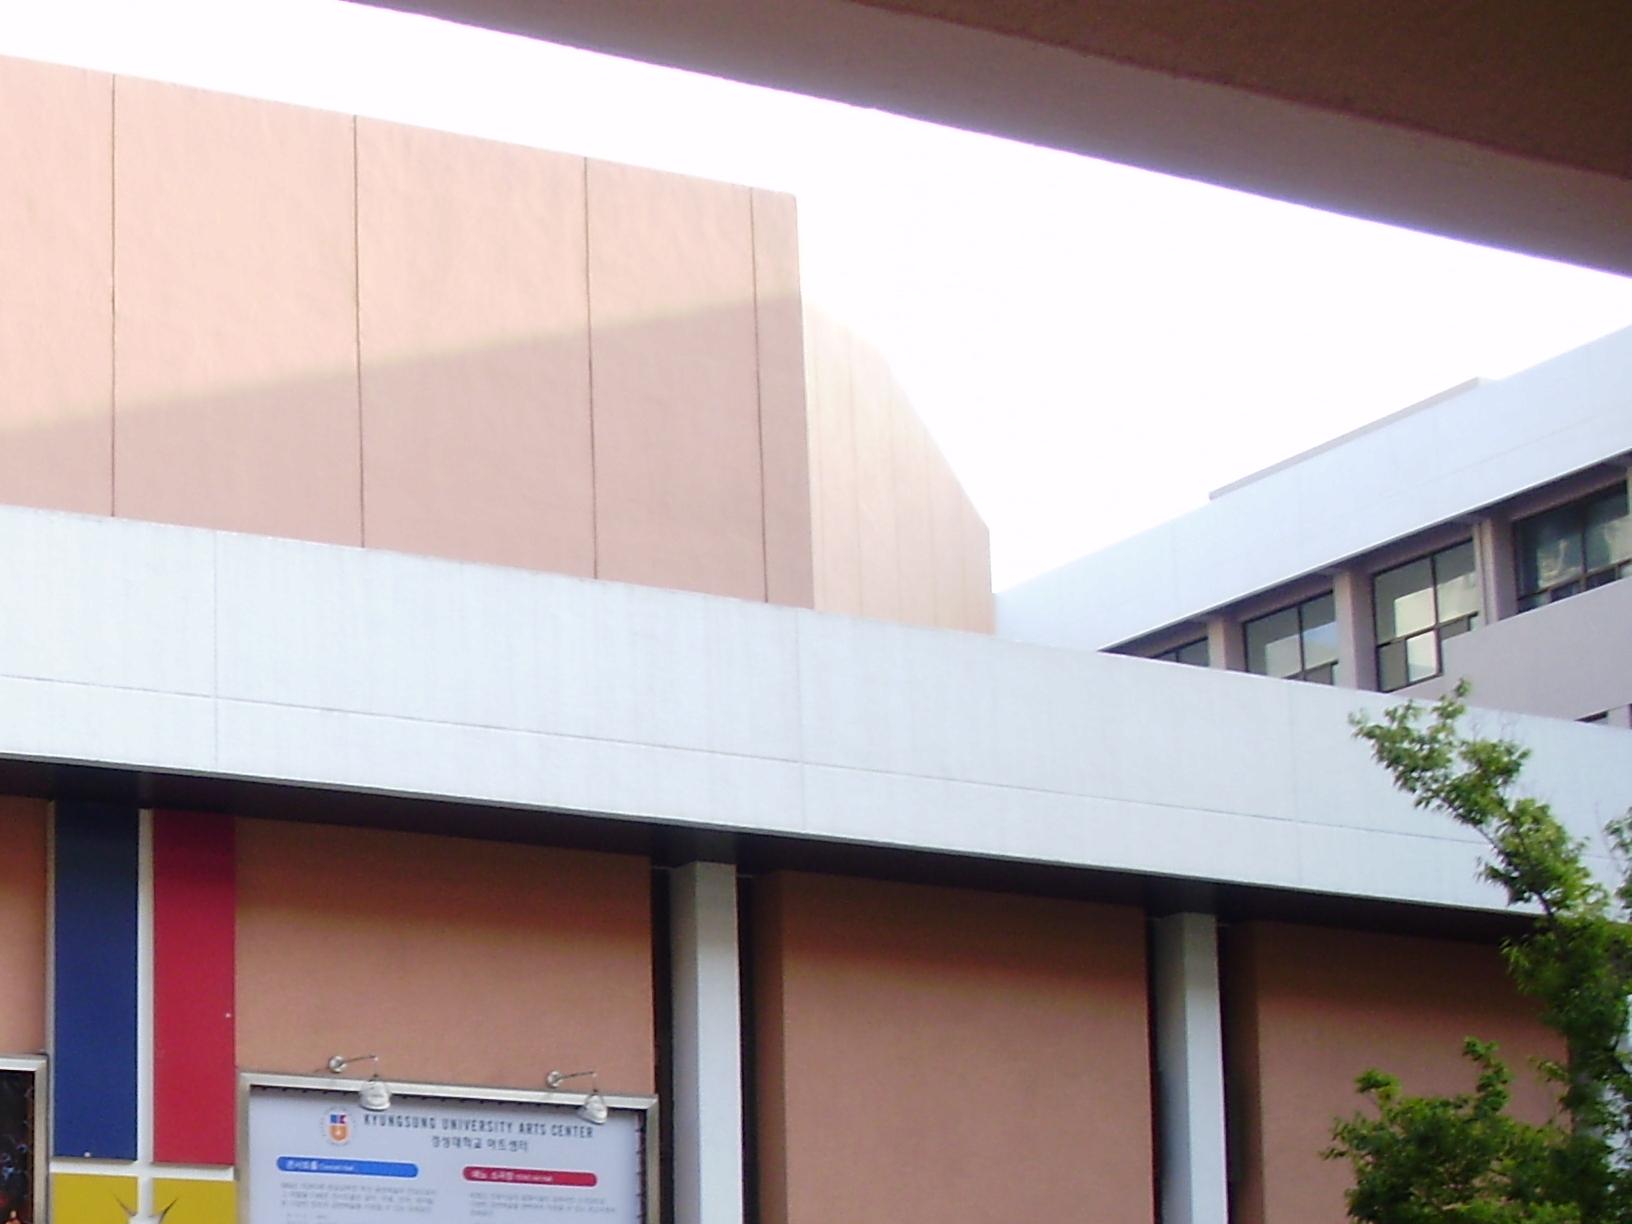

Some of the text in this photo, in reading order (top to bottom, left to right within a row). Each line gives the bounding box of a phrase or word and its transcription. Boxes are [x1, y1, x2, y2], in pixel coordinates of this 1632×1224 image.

[364, 1114, 594, 1139] KYUNGSUNG UNIVERSITY ARTS CENTER
